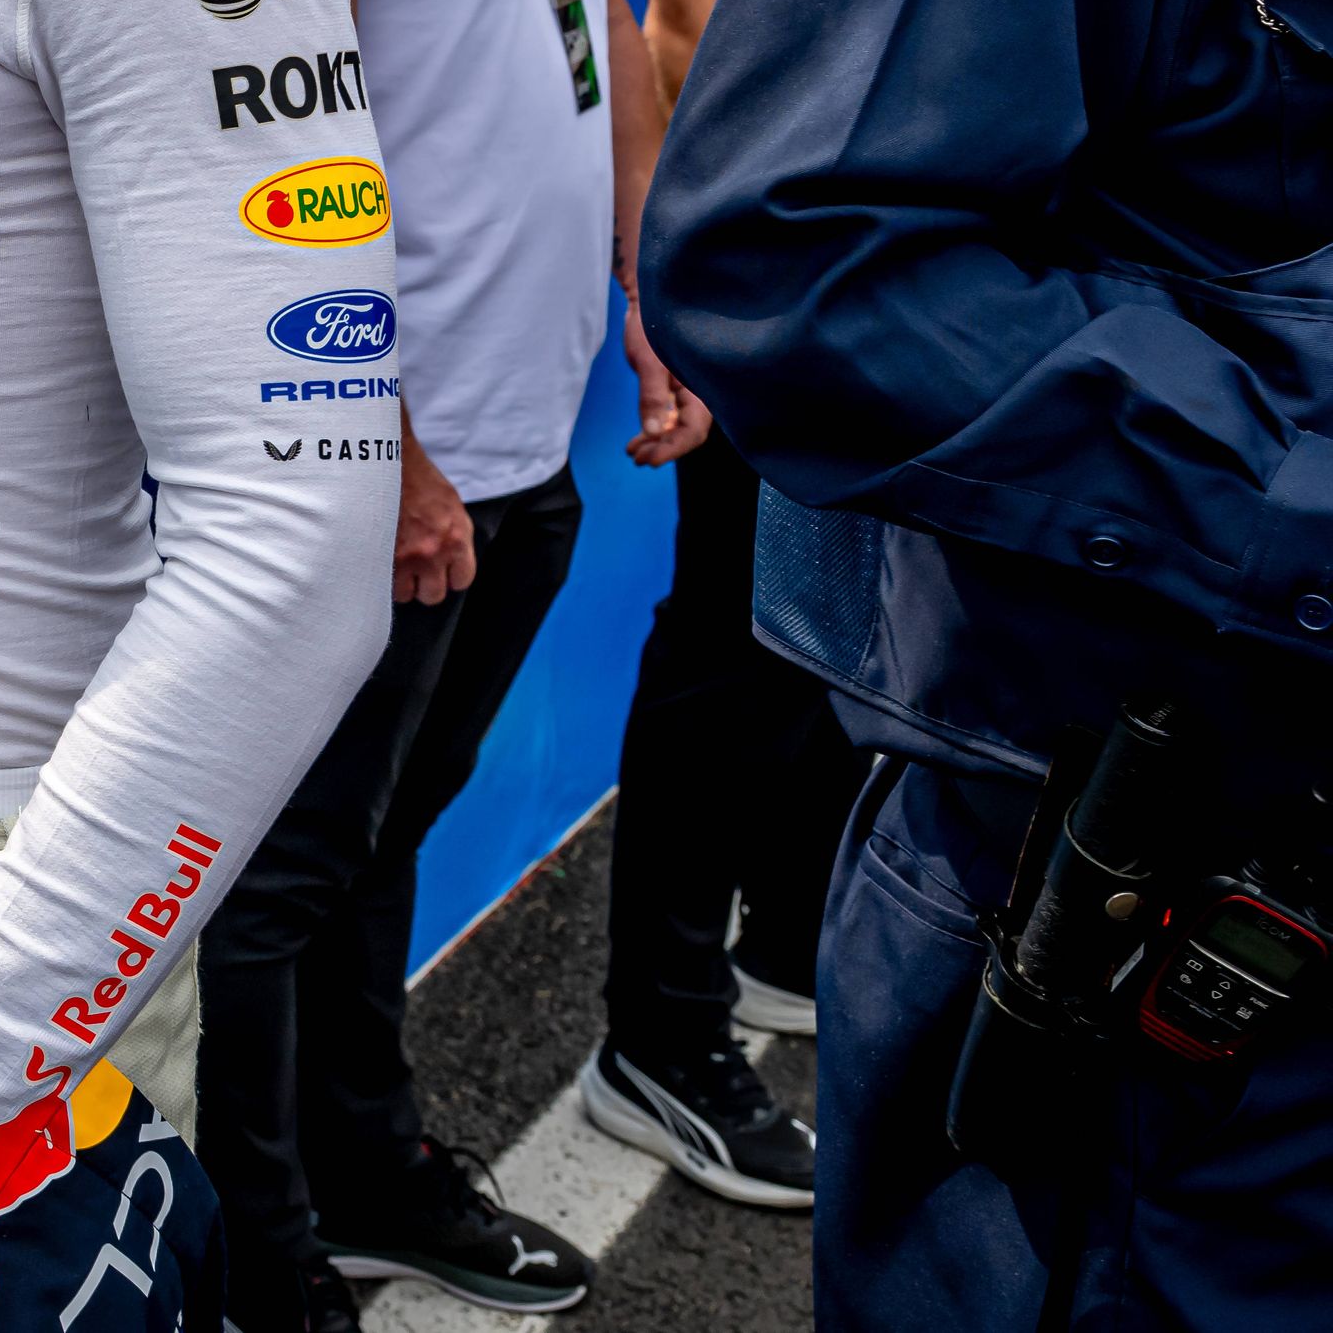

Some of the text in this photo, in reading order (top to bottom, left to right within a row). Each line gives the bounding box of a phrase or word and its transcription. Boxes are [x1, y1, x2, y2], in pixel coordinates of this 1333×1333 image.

[212, 50, 368, 131] ROKT
[296, 180, 387, 225] RAUCH
[305, 302, 387, 350] Ford
[49, 822, 223, 1045] Red Bull
